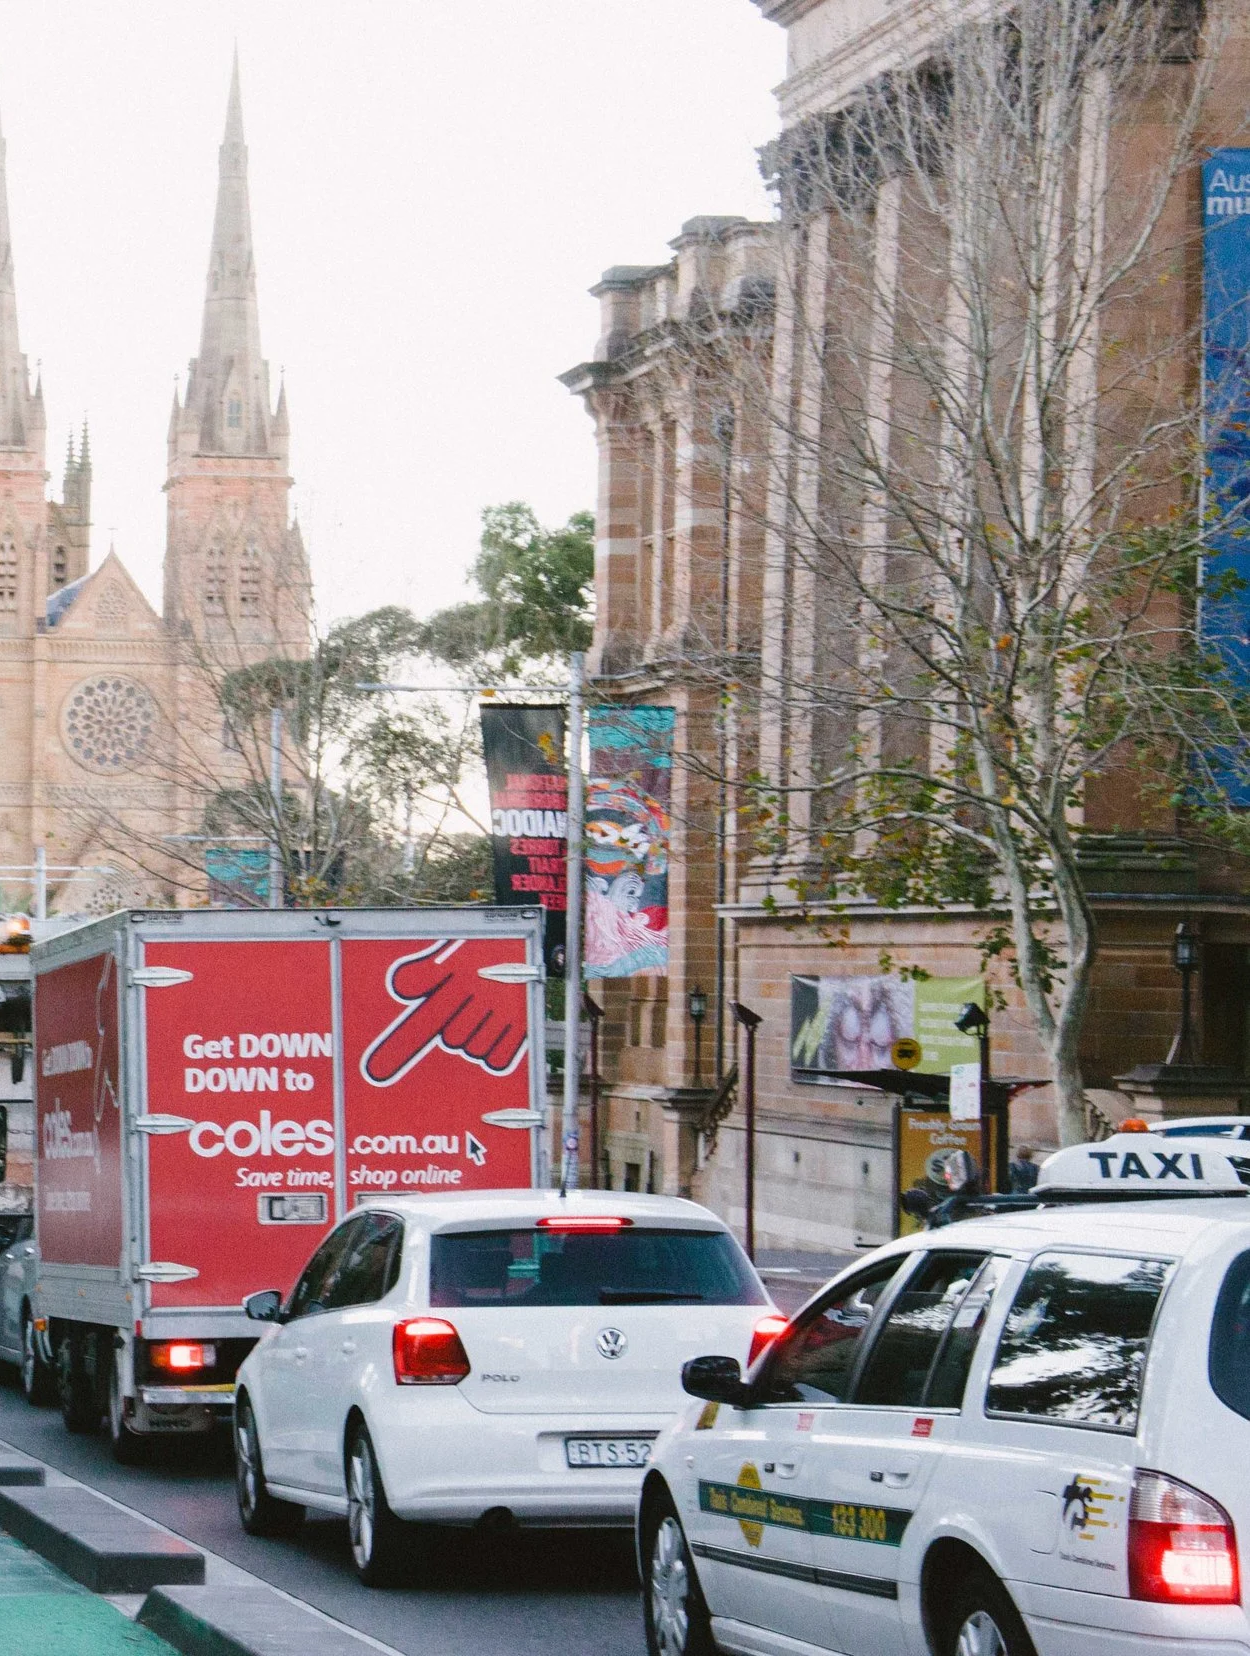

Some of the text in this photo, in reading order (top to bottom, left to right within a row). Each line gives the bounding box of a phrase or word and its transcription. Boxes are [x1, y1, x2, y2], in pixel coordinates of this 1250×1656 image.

[182, 1032, 333, 1059] Get DOWN
[184, 1067, 315, 1093] DOWN to
[188, 1109, 459, 1158] coles .com.au
[235, 1163, 463, 1190] Save time, shop online
[1088, 1151, 1205, 1180] TAXI
[481, 1373, 521, 1383] POLO
